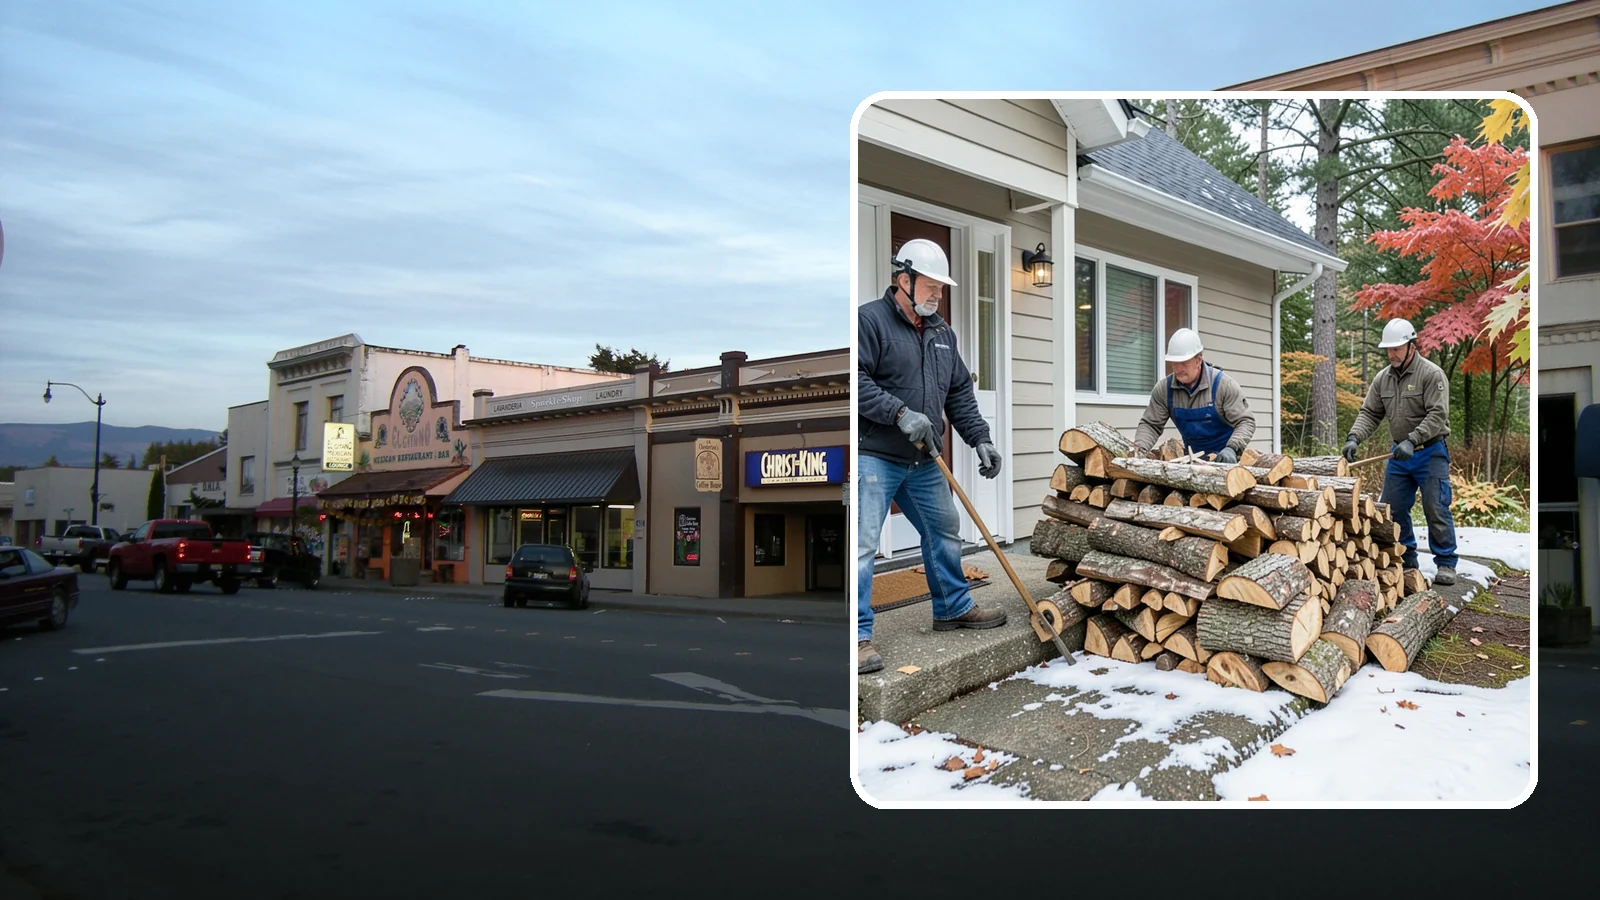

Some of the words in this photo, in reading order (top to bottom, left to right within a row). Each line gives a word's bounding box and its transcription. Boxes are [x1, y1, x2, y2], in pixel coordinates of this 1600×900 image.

[561, 394, 582, 404] Shop
[595, 389, 623, 400] LAUNDRY
[493, 402, 522, 413] LAVANDERIA
[373, 455, 396, 464] MEXICAN
[397, 451, 434, 463] RESTAURANT
[438, 449, 450, 459] BAR
[761, 452, 797, 478] CHRIST
[799, 450, 827, 477] KING
